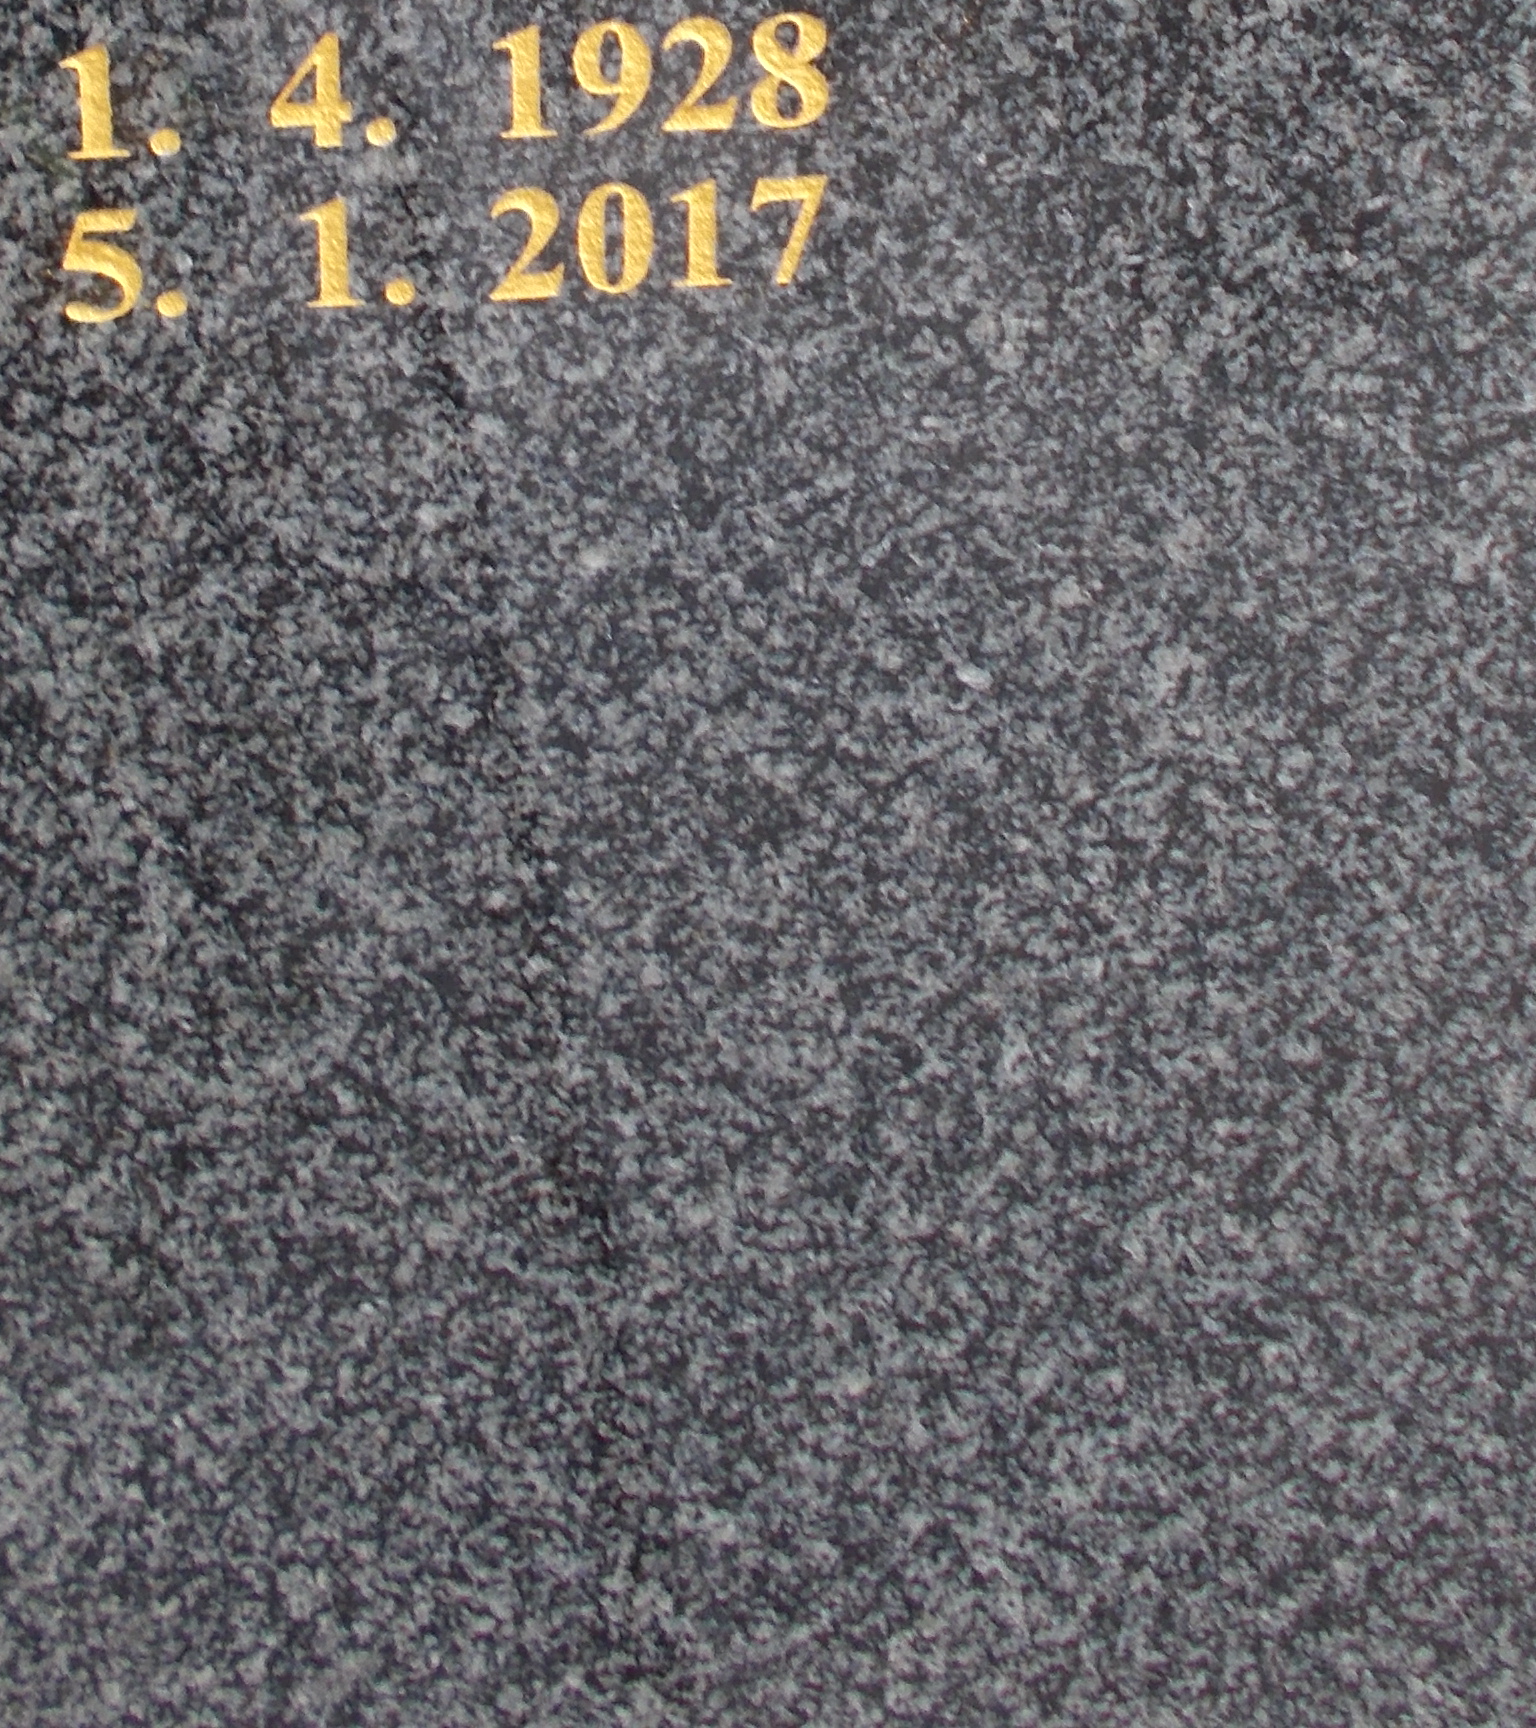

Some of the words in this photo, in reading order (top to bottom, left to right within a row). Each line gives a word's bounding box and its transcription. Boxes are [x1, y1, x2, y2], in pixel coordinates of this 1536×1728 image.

[60, 42, 183, 162] 1.
[266, 30, 402, 150] 4.
[493, 10, 831, 141] 1928
[60, 206, 188, 324] 5.
[303, 196, 417, 310] 1.
[488, 172, 831, 303] 2017
